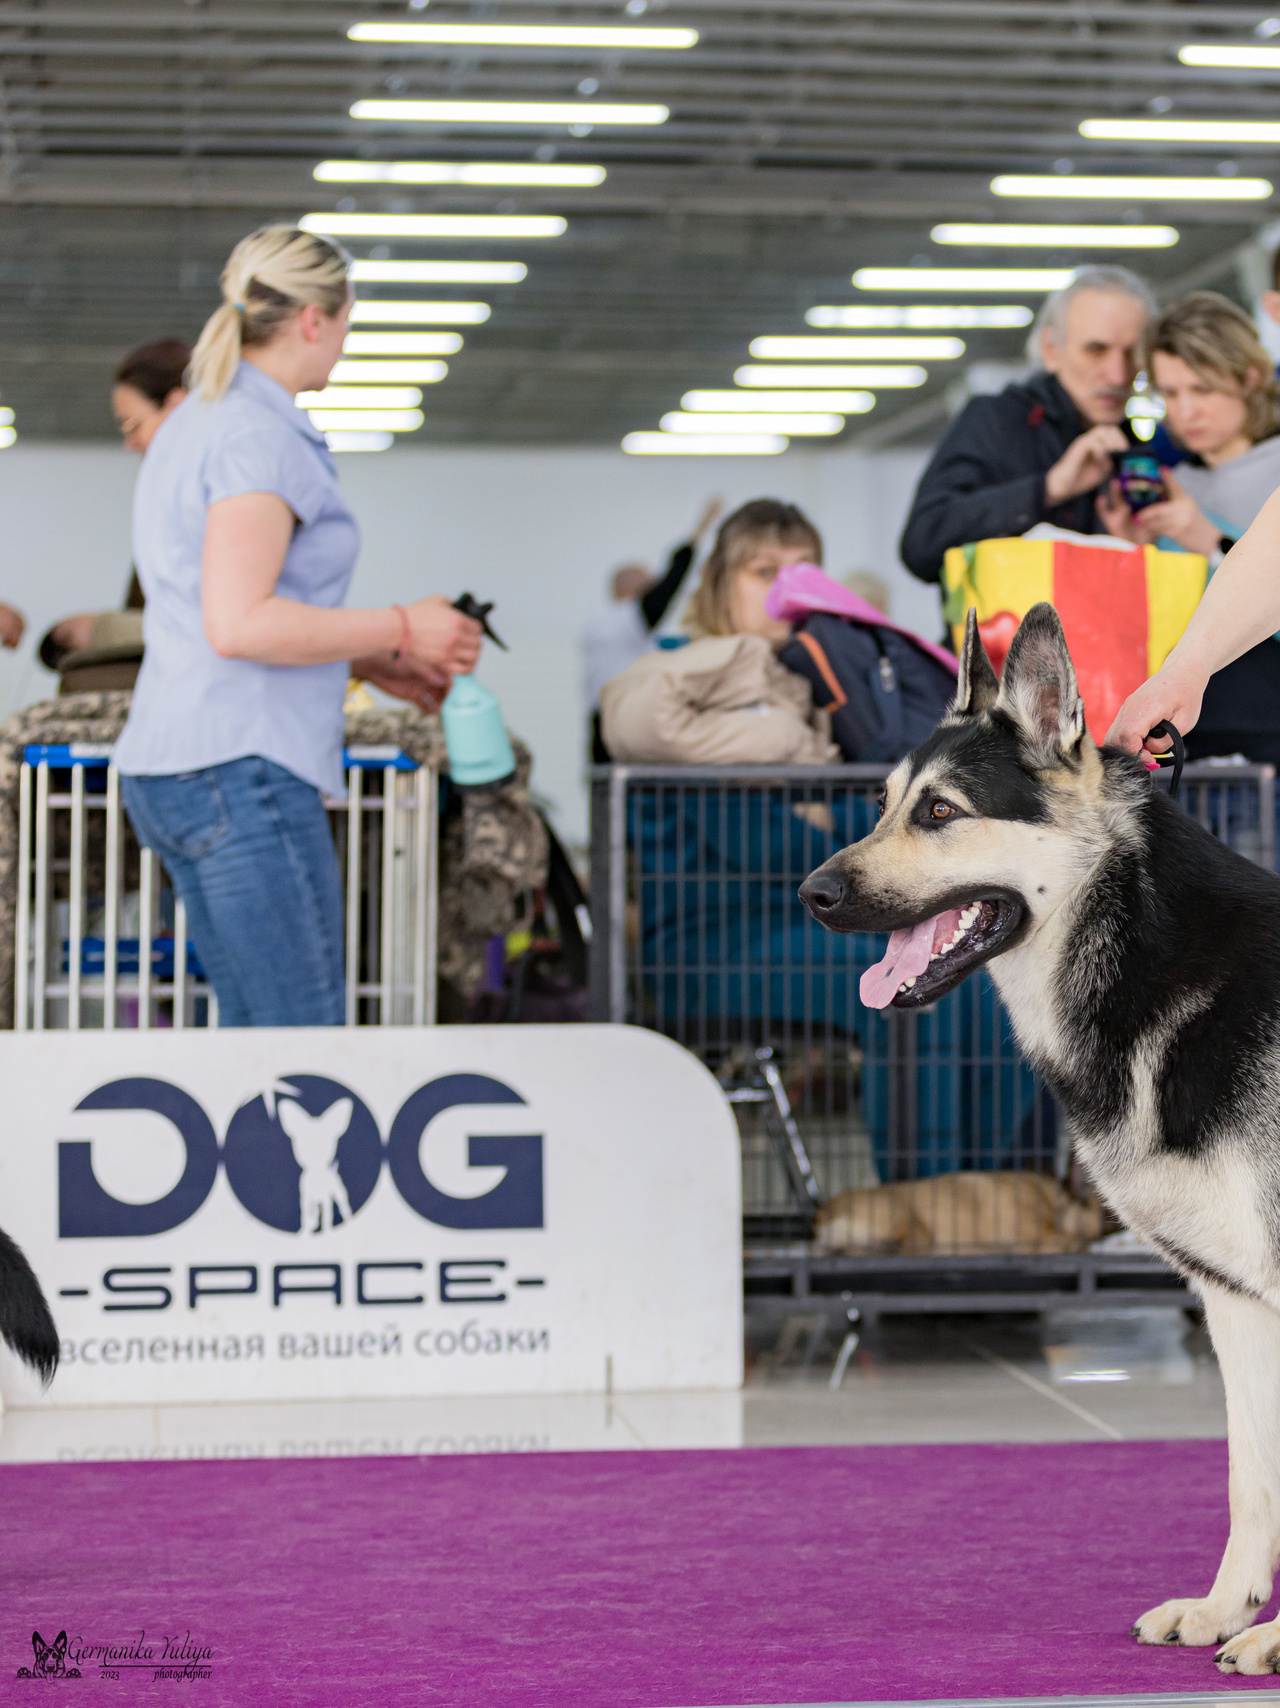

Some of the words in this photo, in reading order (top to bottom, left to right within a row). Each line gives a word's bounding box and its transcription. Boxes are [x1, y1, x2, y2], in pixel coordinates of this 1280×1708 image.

[58, 1073, 544, 1239] DOG
[280, 1323, 401, 1358] вашей
[416, 1319, 548, 1355] собаки
